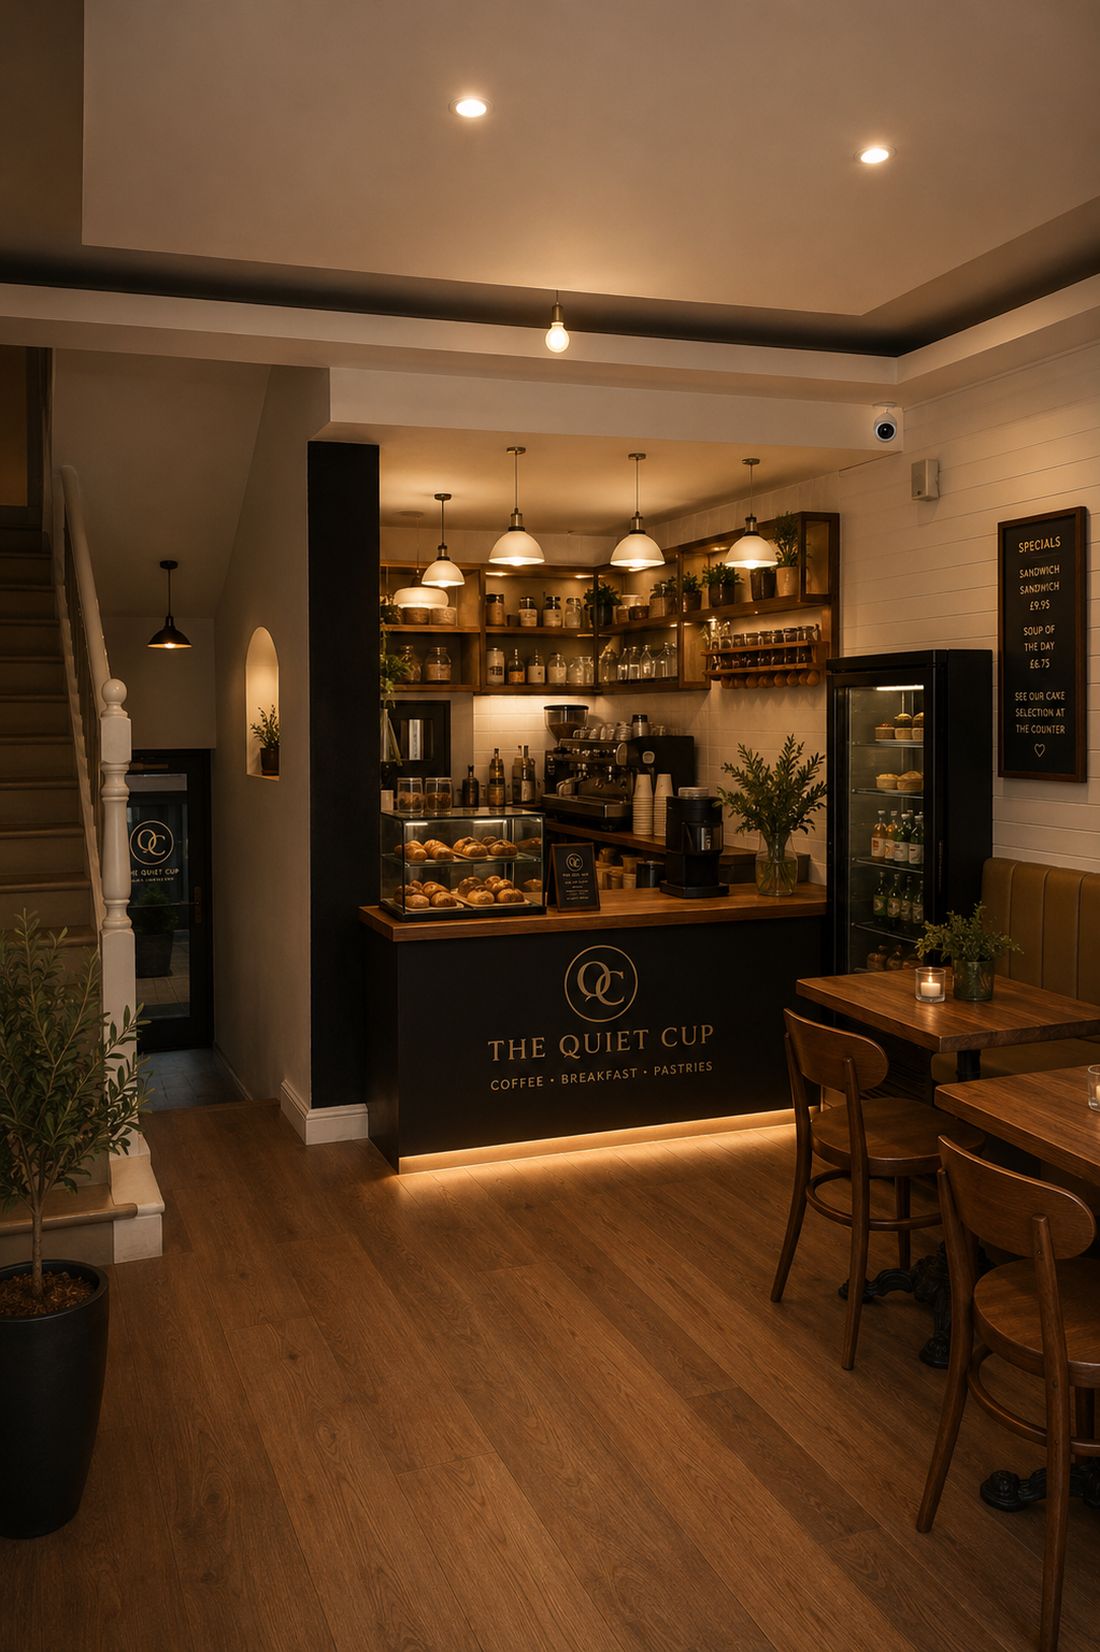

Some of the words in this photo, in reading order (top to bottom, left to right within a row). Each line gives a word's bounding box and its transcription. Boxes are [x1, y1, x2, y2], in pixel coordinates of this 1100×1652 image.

[1018, 536, 1061, 553] SPECIALS
[1019, 564, 1060, 579] SANDWICH
[1019, 581, 1060, 595] SANDWICH
[1029, 599, 1050, 611] £9.95
[1023, 626, 1043, 636] SOUP
[1044, 624, 1056, 634] OF
[1024, 642, 1038, 652] THE
[1040, 641, 1055, 651] DAY
[1029, 658, 1050, 669] £6.75
[1015, 692, 1027, 701] SEE
[1029, 692, 1044, 701] OUR
[1045, 691, 1065, 700] CAKE
[1015, 708, 1054, 717] SELECTION
[1055, 708, 1066, 717] AT
[1016, 724, 1029, 734] THE
[1030, 724, 1065, 734] COUNTER
[576, 960, 625, 1006] QC
[487, 1037, 546, 1062] THE
[559, 1028, 649, 1060] QUIET
[661, 1024, 714, 1048] CUP
[490, 1076, 544, 1091] COFFEE
[561, 1067, 638, 1085] BREAKFAST
[654, 1060, 713, 1077] PASTRIES
